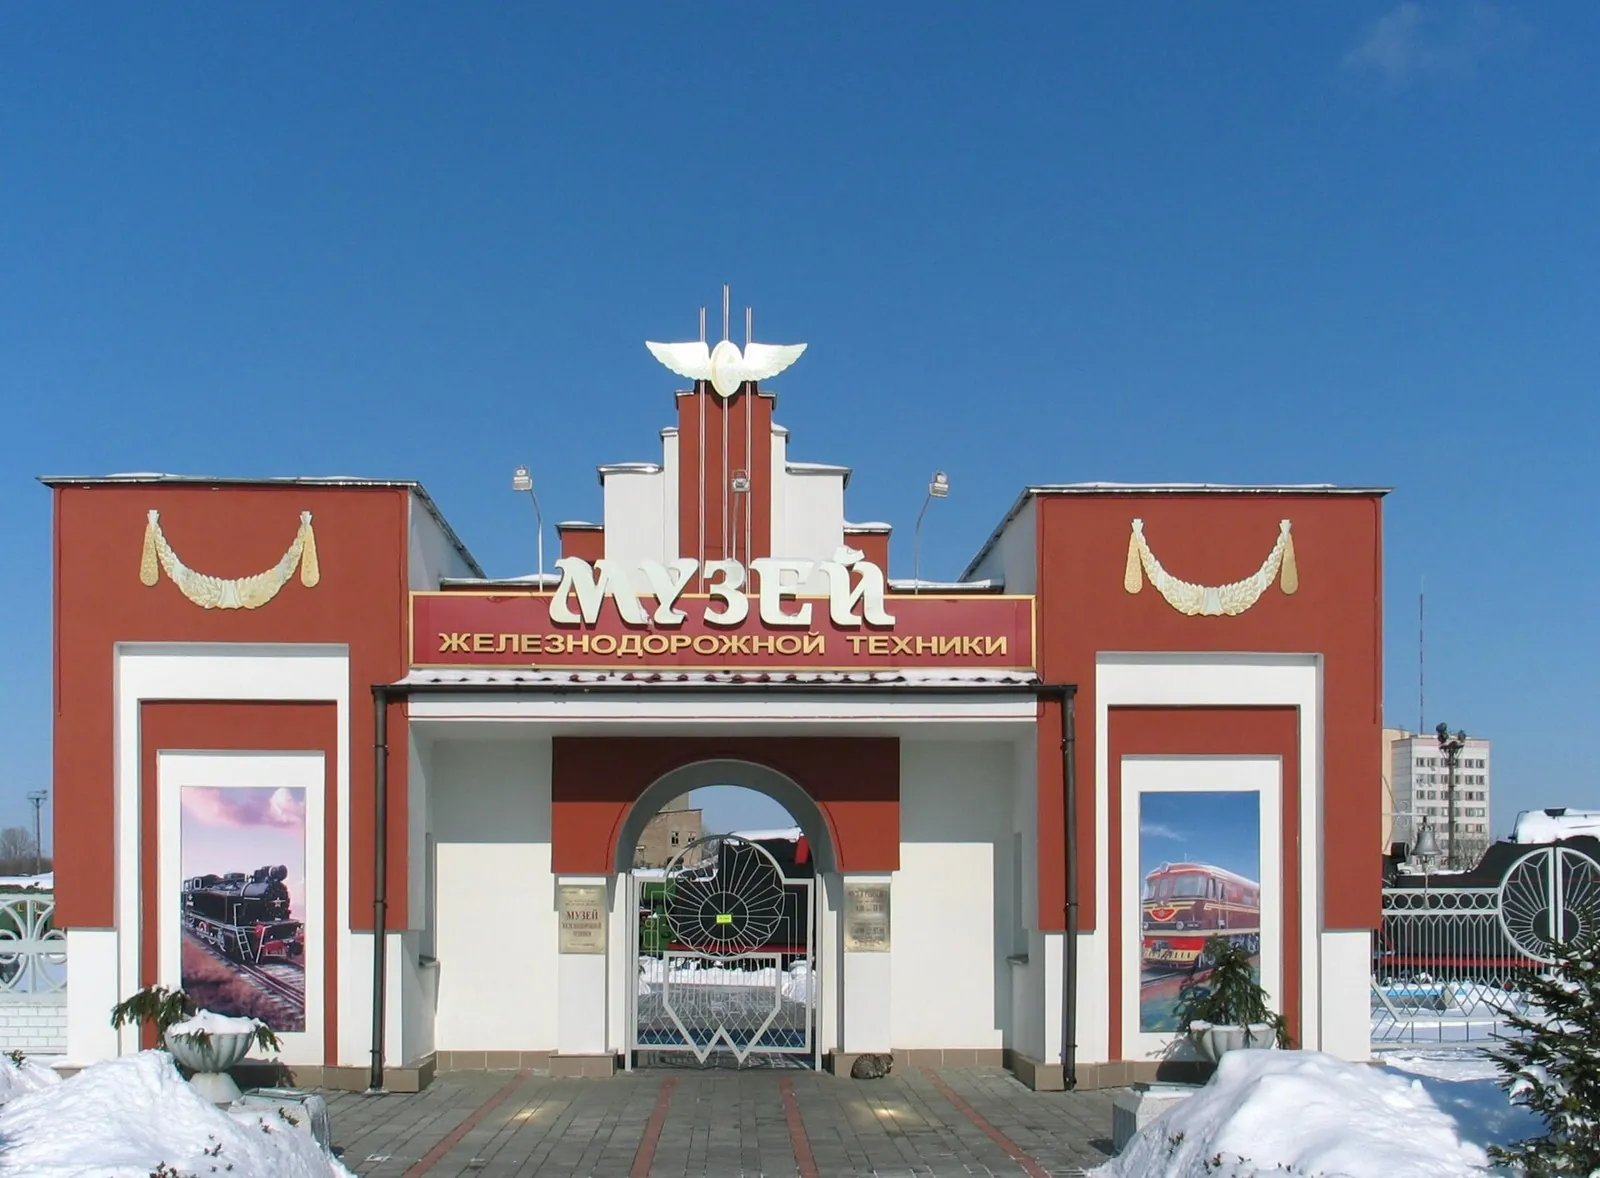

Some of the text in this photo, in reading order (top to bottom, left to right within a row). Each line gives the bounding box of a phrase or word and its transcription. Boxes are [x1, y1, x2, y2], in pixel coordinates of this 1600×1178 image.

[549, 545, 896, 626] МУЗЕЙ
[438, 631, 1008, 657] ЖЕЛЕЗНОДОРОЖНОЙ ТЕХНИКИ
[566, 909, 599, 920] МУЗЕЙ
